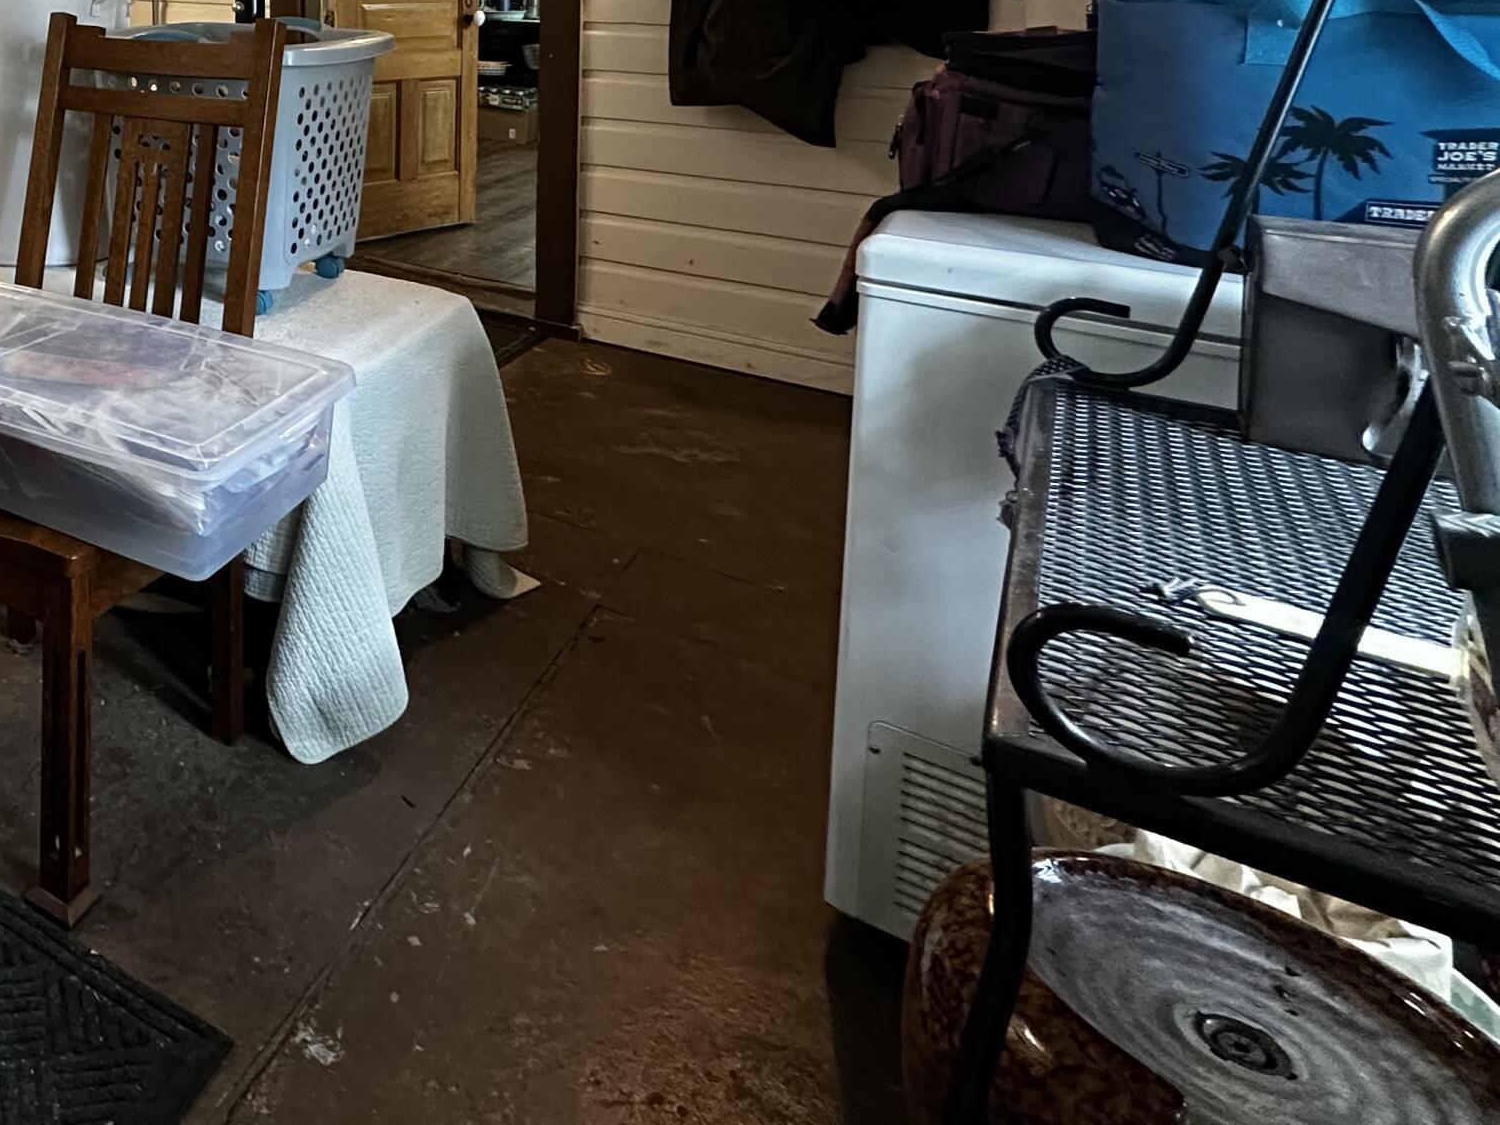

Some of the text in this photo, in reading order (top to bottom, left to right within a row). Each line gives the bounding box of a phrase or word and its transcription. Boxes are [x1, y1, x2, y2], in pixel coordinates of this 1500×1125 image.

[1437, 141, 1500, 151] TRADER
[1437, 151, 1497, 162] JOE'S
[1436, 163, 1496, 171] MARKET
